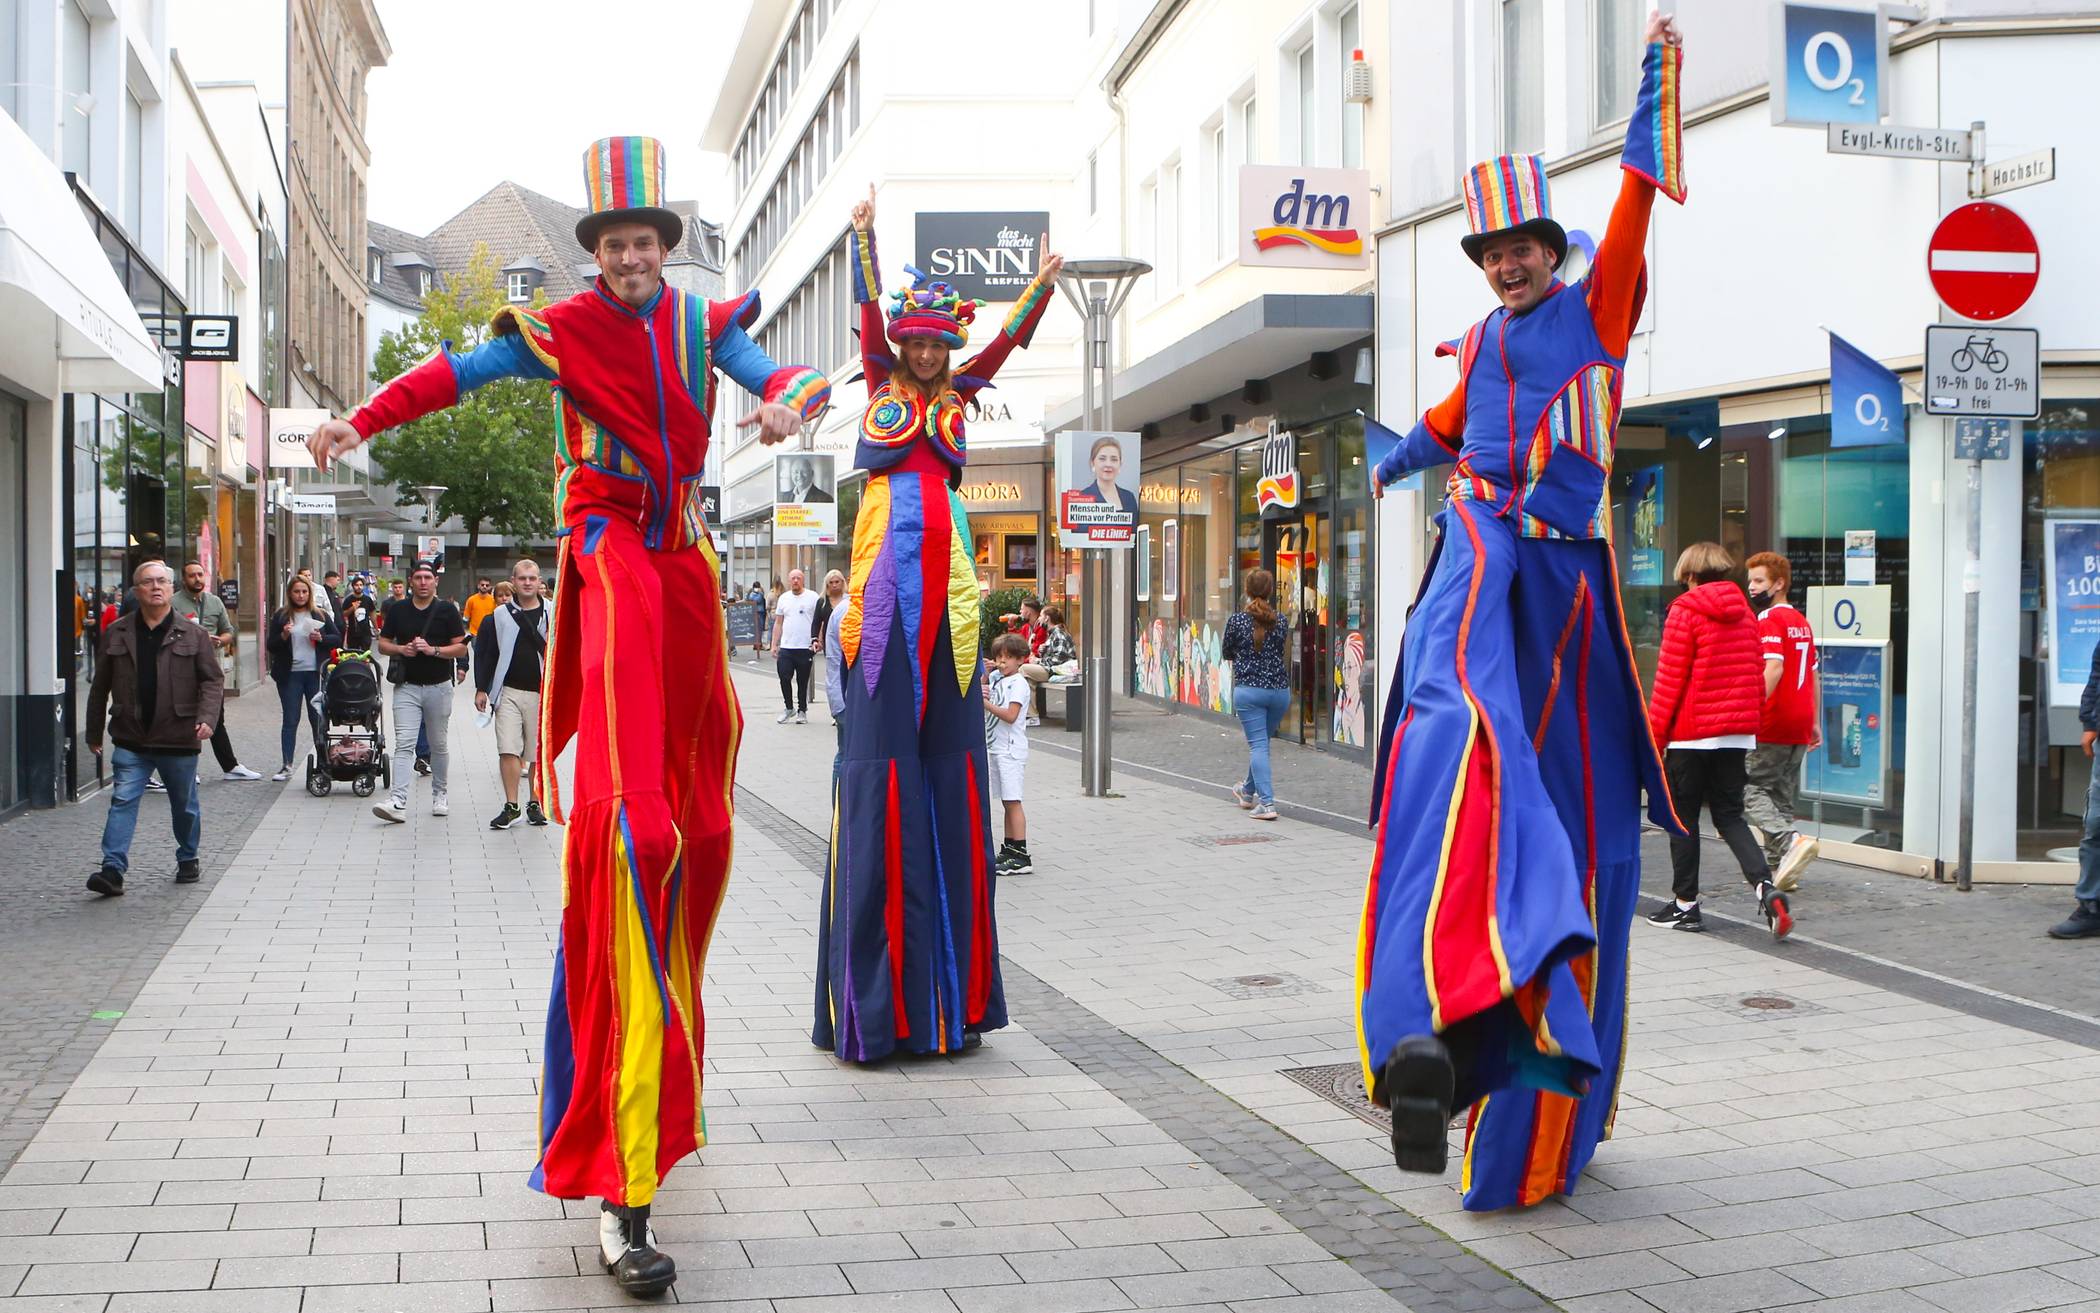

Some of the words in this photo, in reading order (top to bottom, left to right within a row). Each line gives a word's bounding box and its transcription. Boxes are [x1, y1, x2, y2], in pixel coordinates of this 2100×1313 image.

[1273, 178, 1350, 227] dm
[997, 225, 1019, 240] das
[997, 234, 1034, 248] macht
[930, 248, 1034, 276] SiNN
[1975, 377, 1988, 390] Do
[1972, 395, 1991, 409] frei
[1264, 424, 1291, 478] dm
[959, 485, 1020, 500] NDORA
[1070, 504, 1099, 513] Mensch
[1101, 505, 1115, 513] und
[1070, 513, 1092, 522] Klima
[1093, 514, 1105, 522] vor
[1105, 513, 1131, 522] Profite!
[1091, 529, 1105, 538] DIE
[1796, 642, 1809, 690] 7
